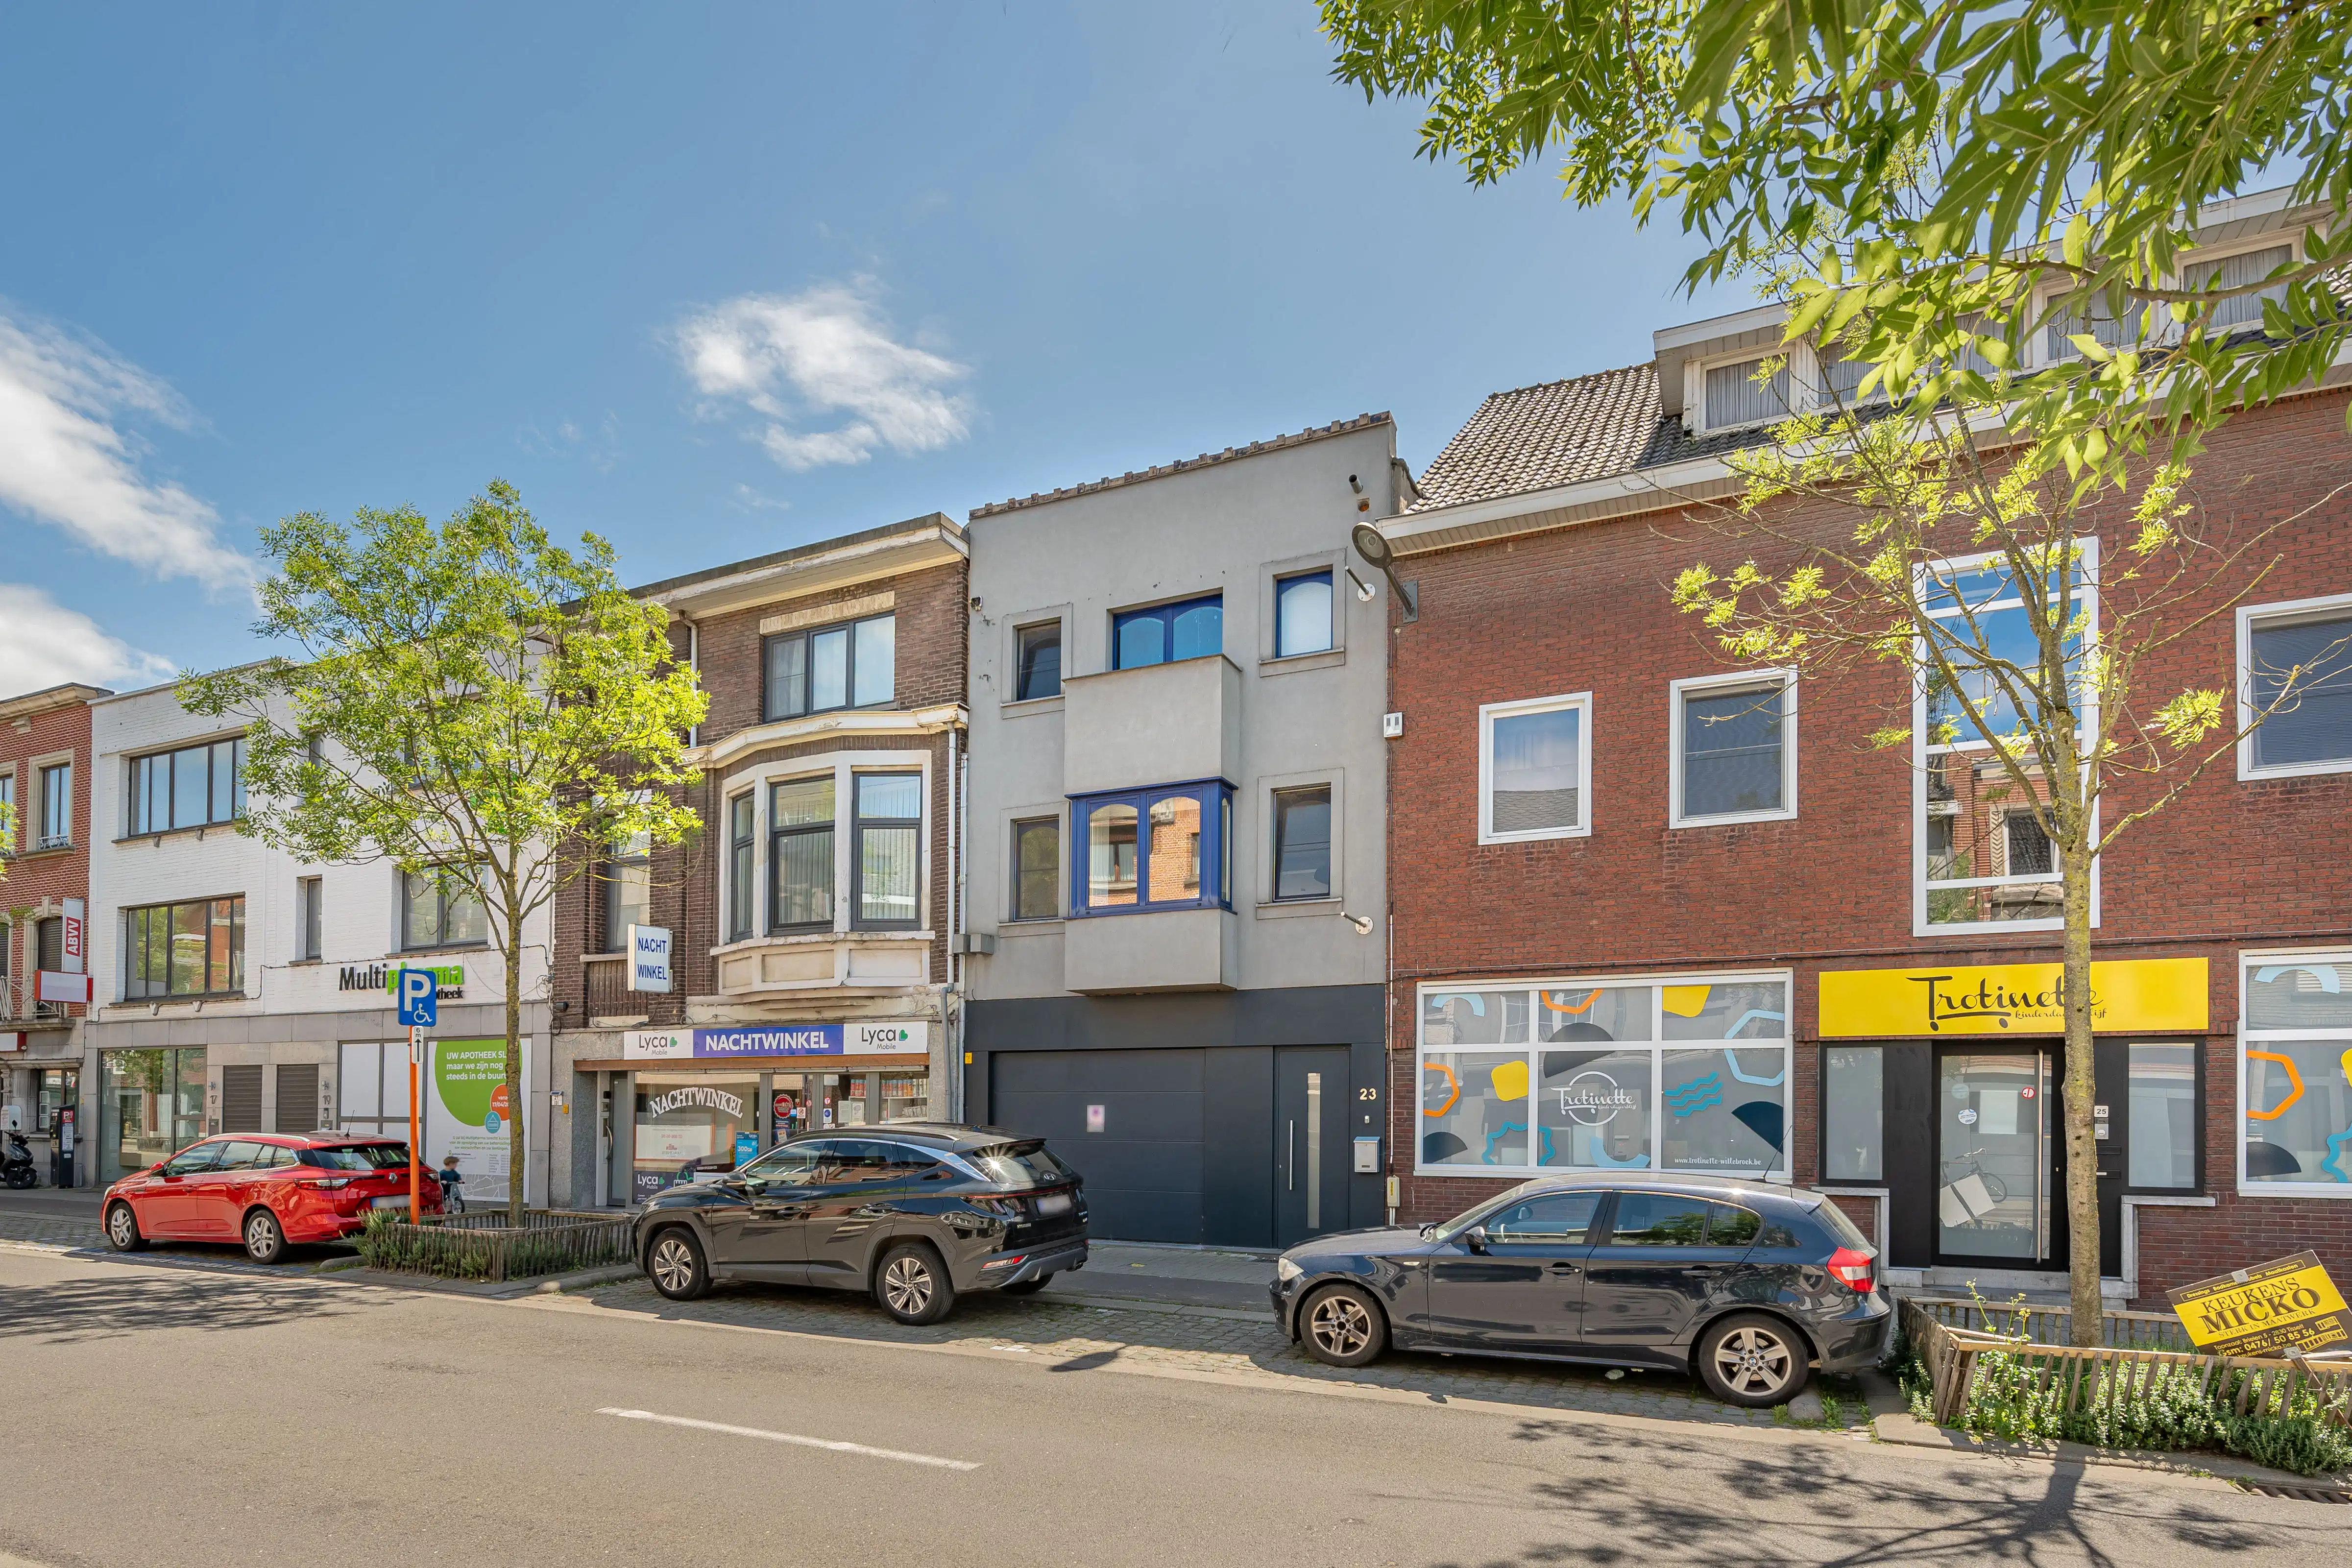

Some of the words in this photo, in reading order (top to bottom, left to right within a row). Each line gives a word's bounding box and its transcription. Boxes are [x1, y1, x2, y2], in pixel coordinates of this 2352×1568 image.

[68, 920, 78, 954] ABVV
[638, 937, 667, 954] NACHT
[339, 962, 464, 995] Multipma
[637, 964, 667, 980] WINKEL
[404, 972, 431, 1012] P
[1905, 975, 2104, 1020] Trotinete
[639, 1035, 668, 1051] Lyca
[705, 1031, 829, 1051] NACHTWINKEL
[861, 1027, 897, 1045] Lyca
[476, 1061, 488, 1071] zijn
[490, 1062, 504, 1071] nog
[210, 1095, 218, 1104] 17
[322, 1095, 331, 1105] 19
[649, 1086, 743, 1119] NACHTWINKEL
[1359, 1088, 1377, 1100] 23
[1551, 1087, 1635, 1110] Trotinette
[1674, 1156, 1762, 1165] www.trotinette-willebroek.be
[638, 1174, 658, 1186] Lyca
[2186, 1289, 2211, 1299] Dressings
[2265, 1263, 2299, 1277] Maatkasten
[2201, 1277, 2300, 1313] KEUKENS
[2198, 1288, 2321, 1334] MICKO
[2218, 1327, 2249, 1338] STERK
[2261, 1309, 2316, 1327] MAATWERK
[2244, 1339, 2271, 1351] 0476/
[2274, 1335, 2286, 1344] 50
[2288, 1331, 2301, 1341] 85
[2303, 1327, 2315, 1336] 56
